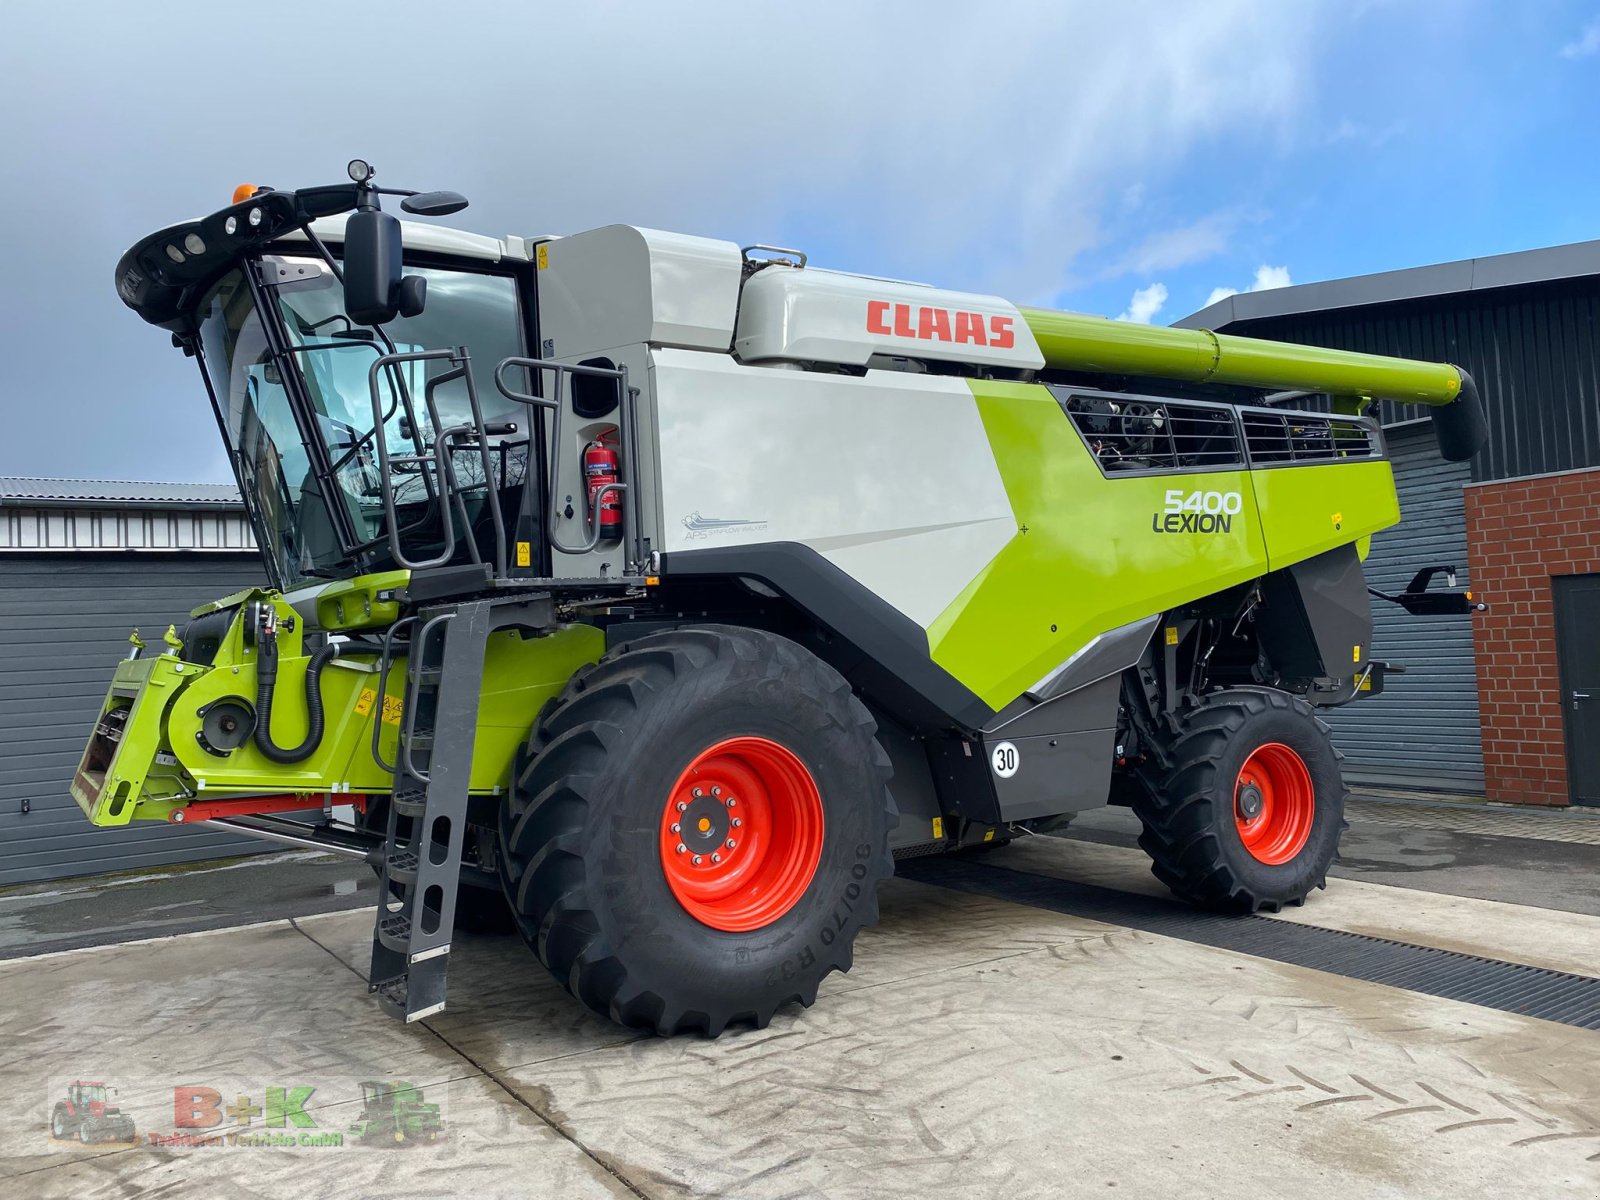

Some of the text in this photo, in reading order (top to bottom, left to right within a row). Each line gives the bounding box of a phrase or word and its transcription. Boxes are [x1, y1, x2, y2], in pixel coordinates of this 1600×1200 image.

[866, 299, 1015, 349] CLAAS
[1164, 489, 1242, 515] 5400
[1152, 512, 1232, 534] LEXION
[684, 530, 708, 541] APS
[997, 748, 1015, 771] 30
[820, 843, 872, 946] 800/70
